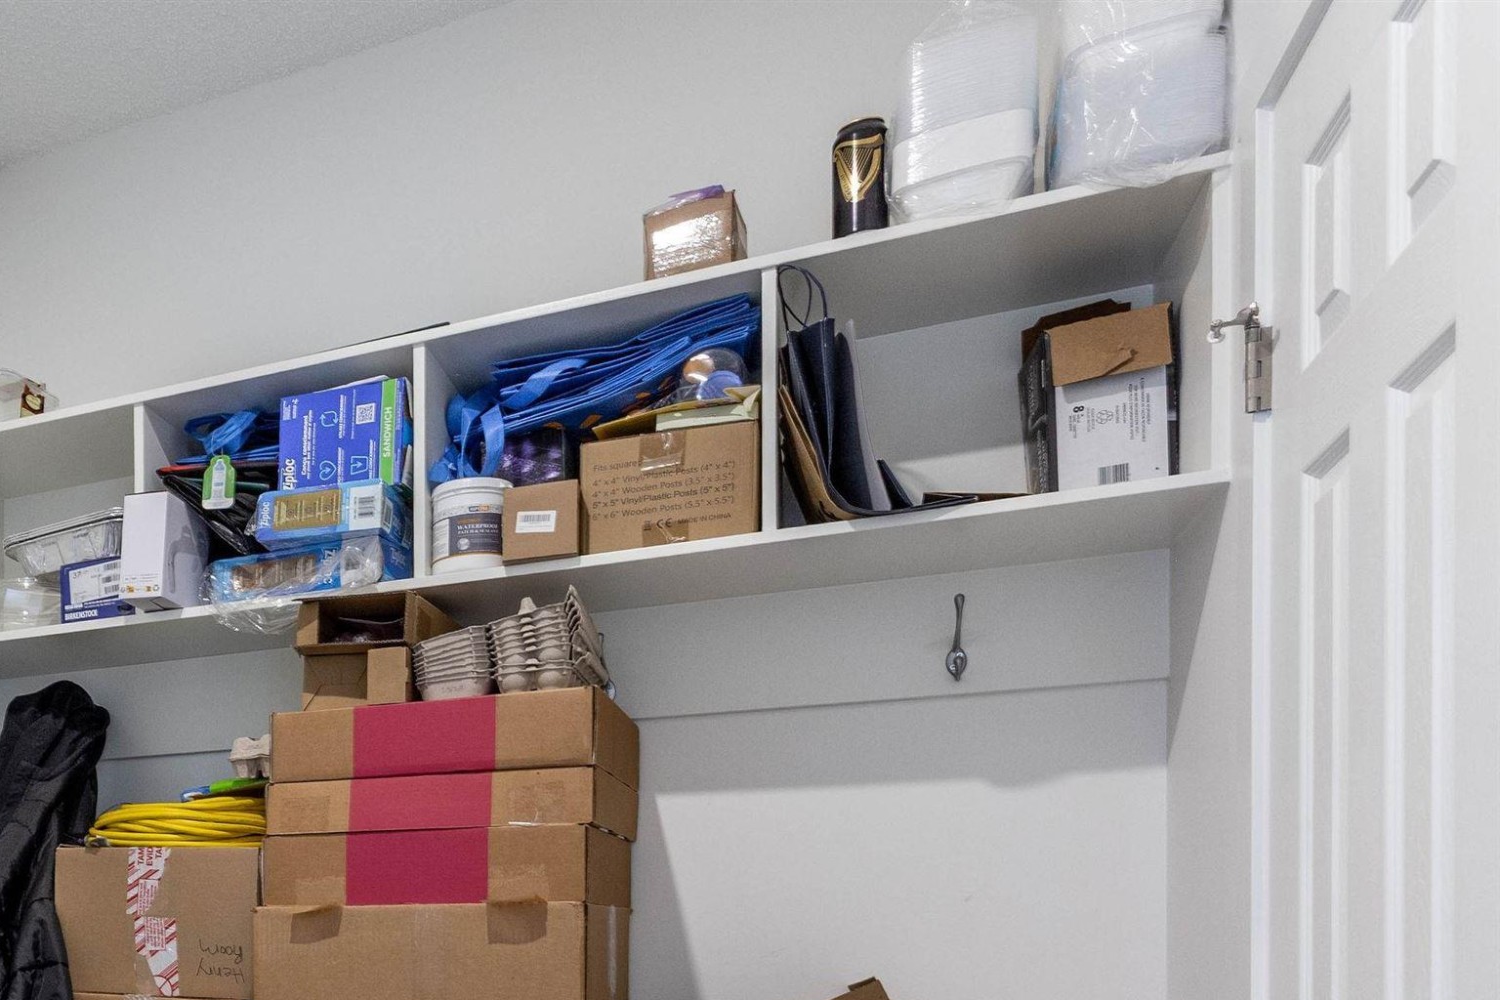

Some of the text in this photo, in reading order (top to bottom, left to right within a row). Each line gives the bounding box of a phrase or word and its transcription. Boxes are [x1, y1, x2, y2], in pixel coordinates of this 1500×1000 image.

[1073, 405, 1084, 413] 8
[382, 406, 393, 458] SANDWICH
[594, 463, 608, 472] Fits
[609, 461, 637, 471] square
[622, 483, 657, 495] Wooden
[660, 480, 682, 489] Posts
[673, 488, 698, 498] Posts
[259, 501, 271, 529] Ziploc
[621, 505, 657, 517] Wooden
[660, 503, 682, 512] Posts
[677, 516, 698, 525] MADE
[700, 515, 707, 523] IN
[708, 512, 732, 521] CHINA
[64, 609, 98, 621] BIRKENSTOCK
[196, 958, 245, 984] Henry
